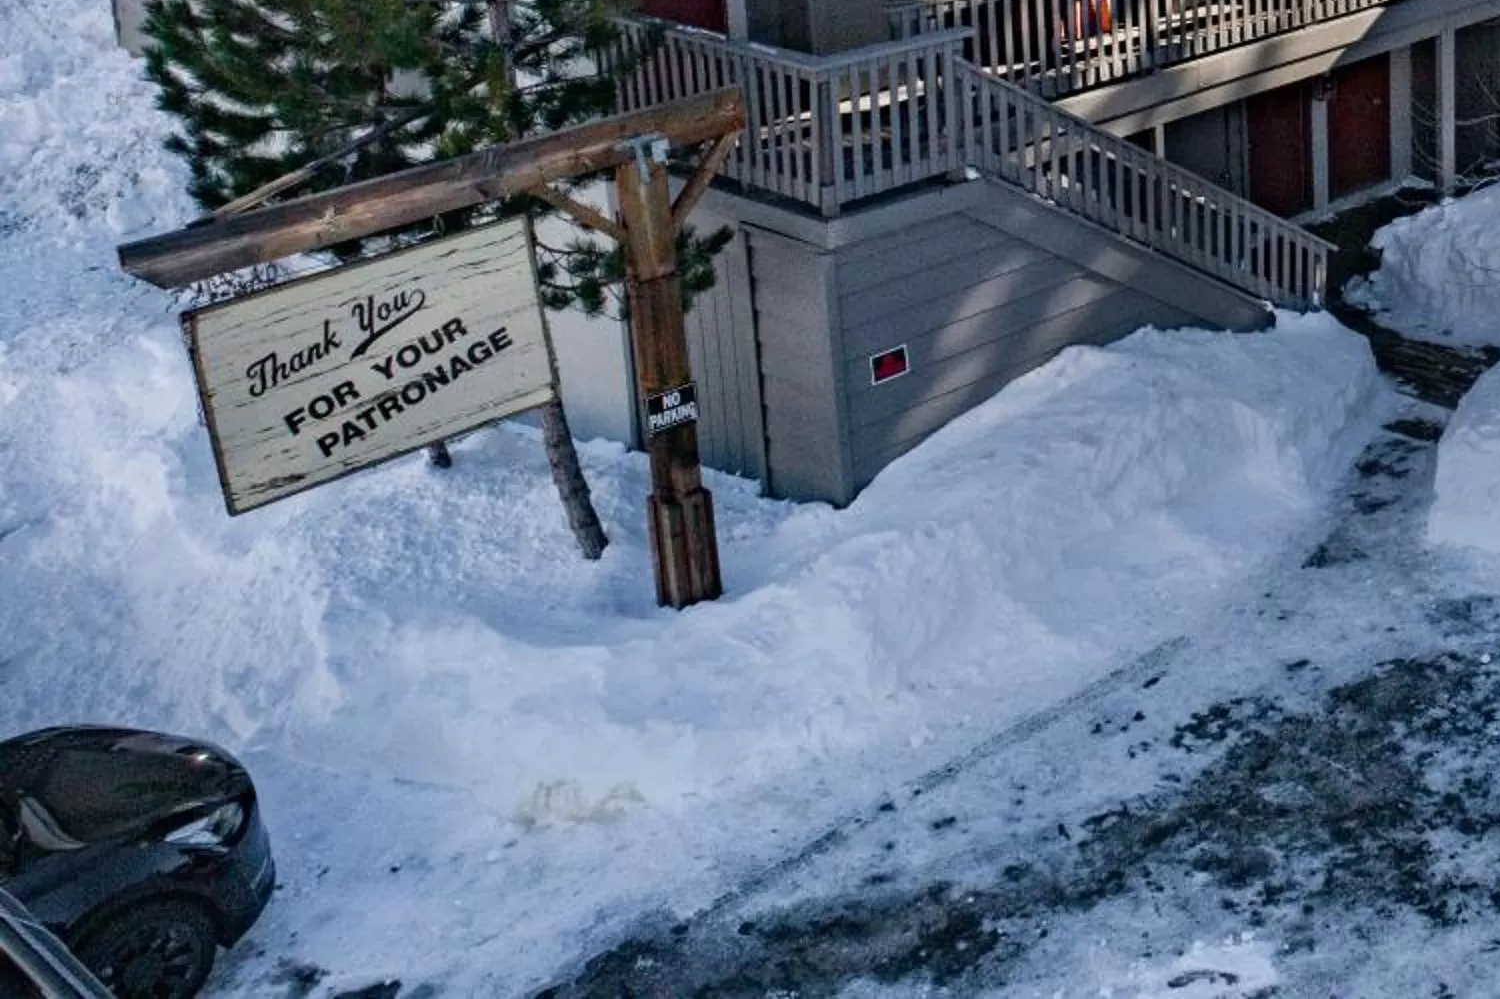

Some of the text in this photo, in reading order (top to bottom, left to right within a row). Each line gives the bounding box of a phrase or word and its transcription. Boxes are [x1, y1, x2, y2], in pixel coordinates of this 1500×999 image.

[246, 289, 426, 397] Thank You
[283, 317, 469, 436] FOR YOUR
[316, 326, 514, 458] PATRONAGE
[649, 401, 698, 431] PARKING
[662, 392, 681, 410] NO
